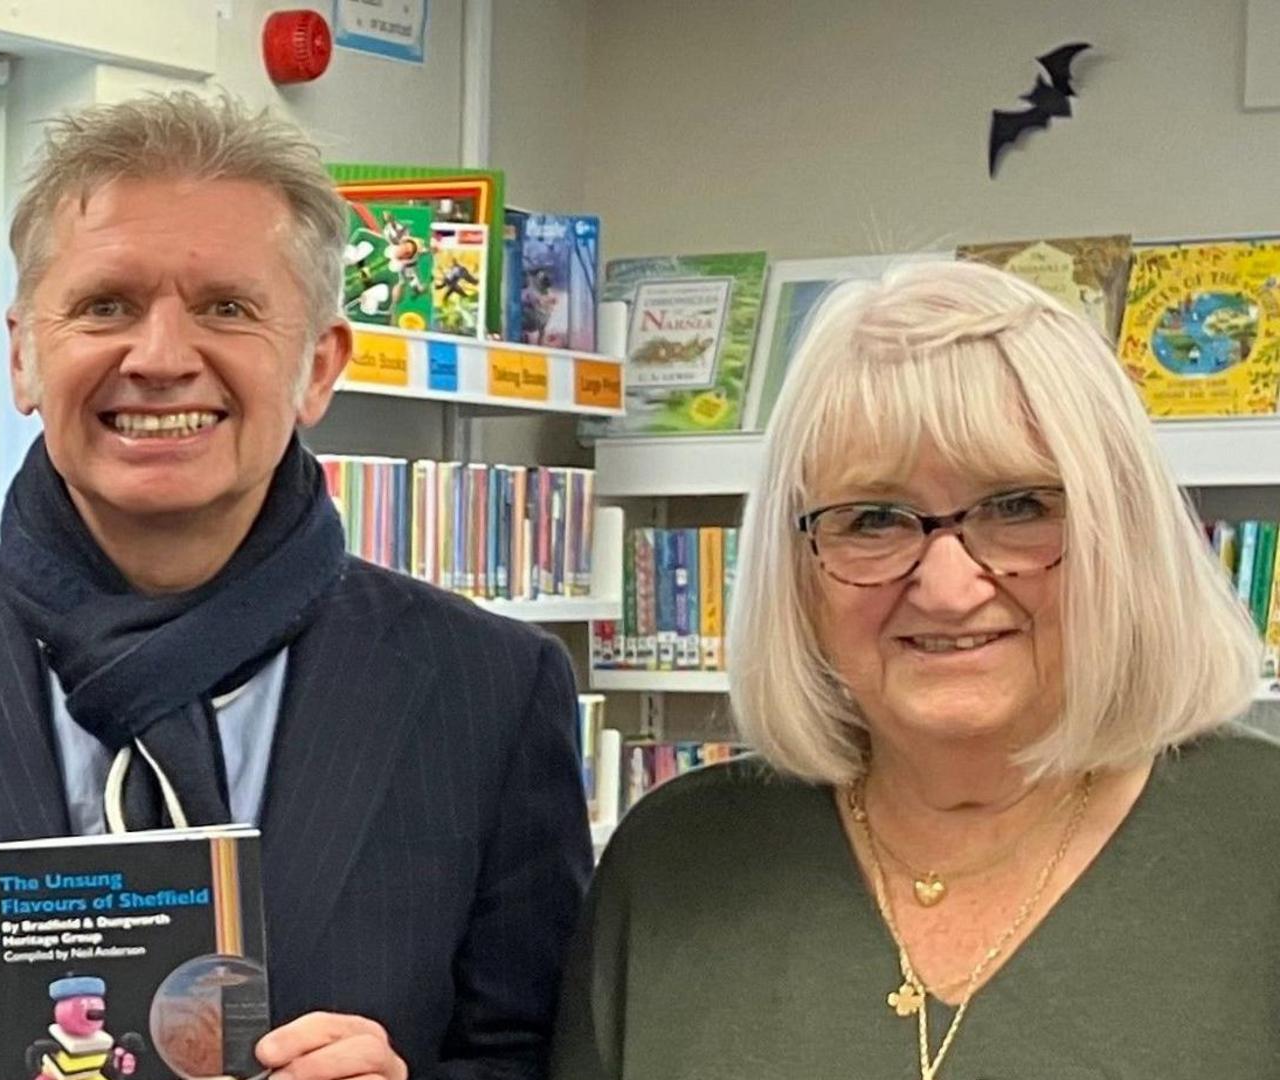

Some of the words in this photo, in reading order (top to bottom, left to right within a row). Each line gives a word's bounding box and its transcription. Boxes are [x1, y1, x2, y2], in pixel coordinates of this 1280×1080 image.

[0, 875, 38, 892] The
[44, 872, 123, 891] Unsung
[0, 895, 88, 915] Flavours
[92, 893, 114, 911] of
[117, 888, 210, 910] Sheffield
[1, 920, 19, 935] By
[21, 916, 81, 933] Bradfield
[96, 912, 171, 932] Dungworth
[2, 931, 59, 949] Heritage
[60, 930, 104, 946] Group
[3, 947, 54, 963] Compiled
[93, 943, 147, 958] Anderson
